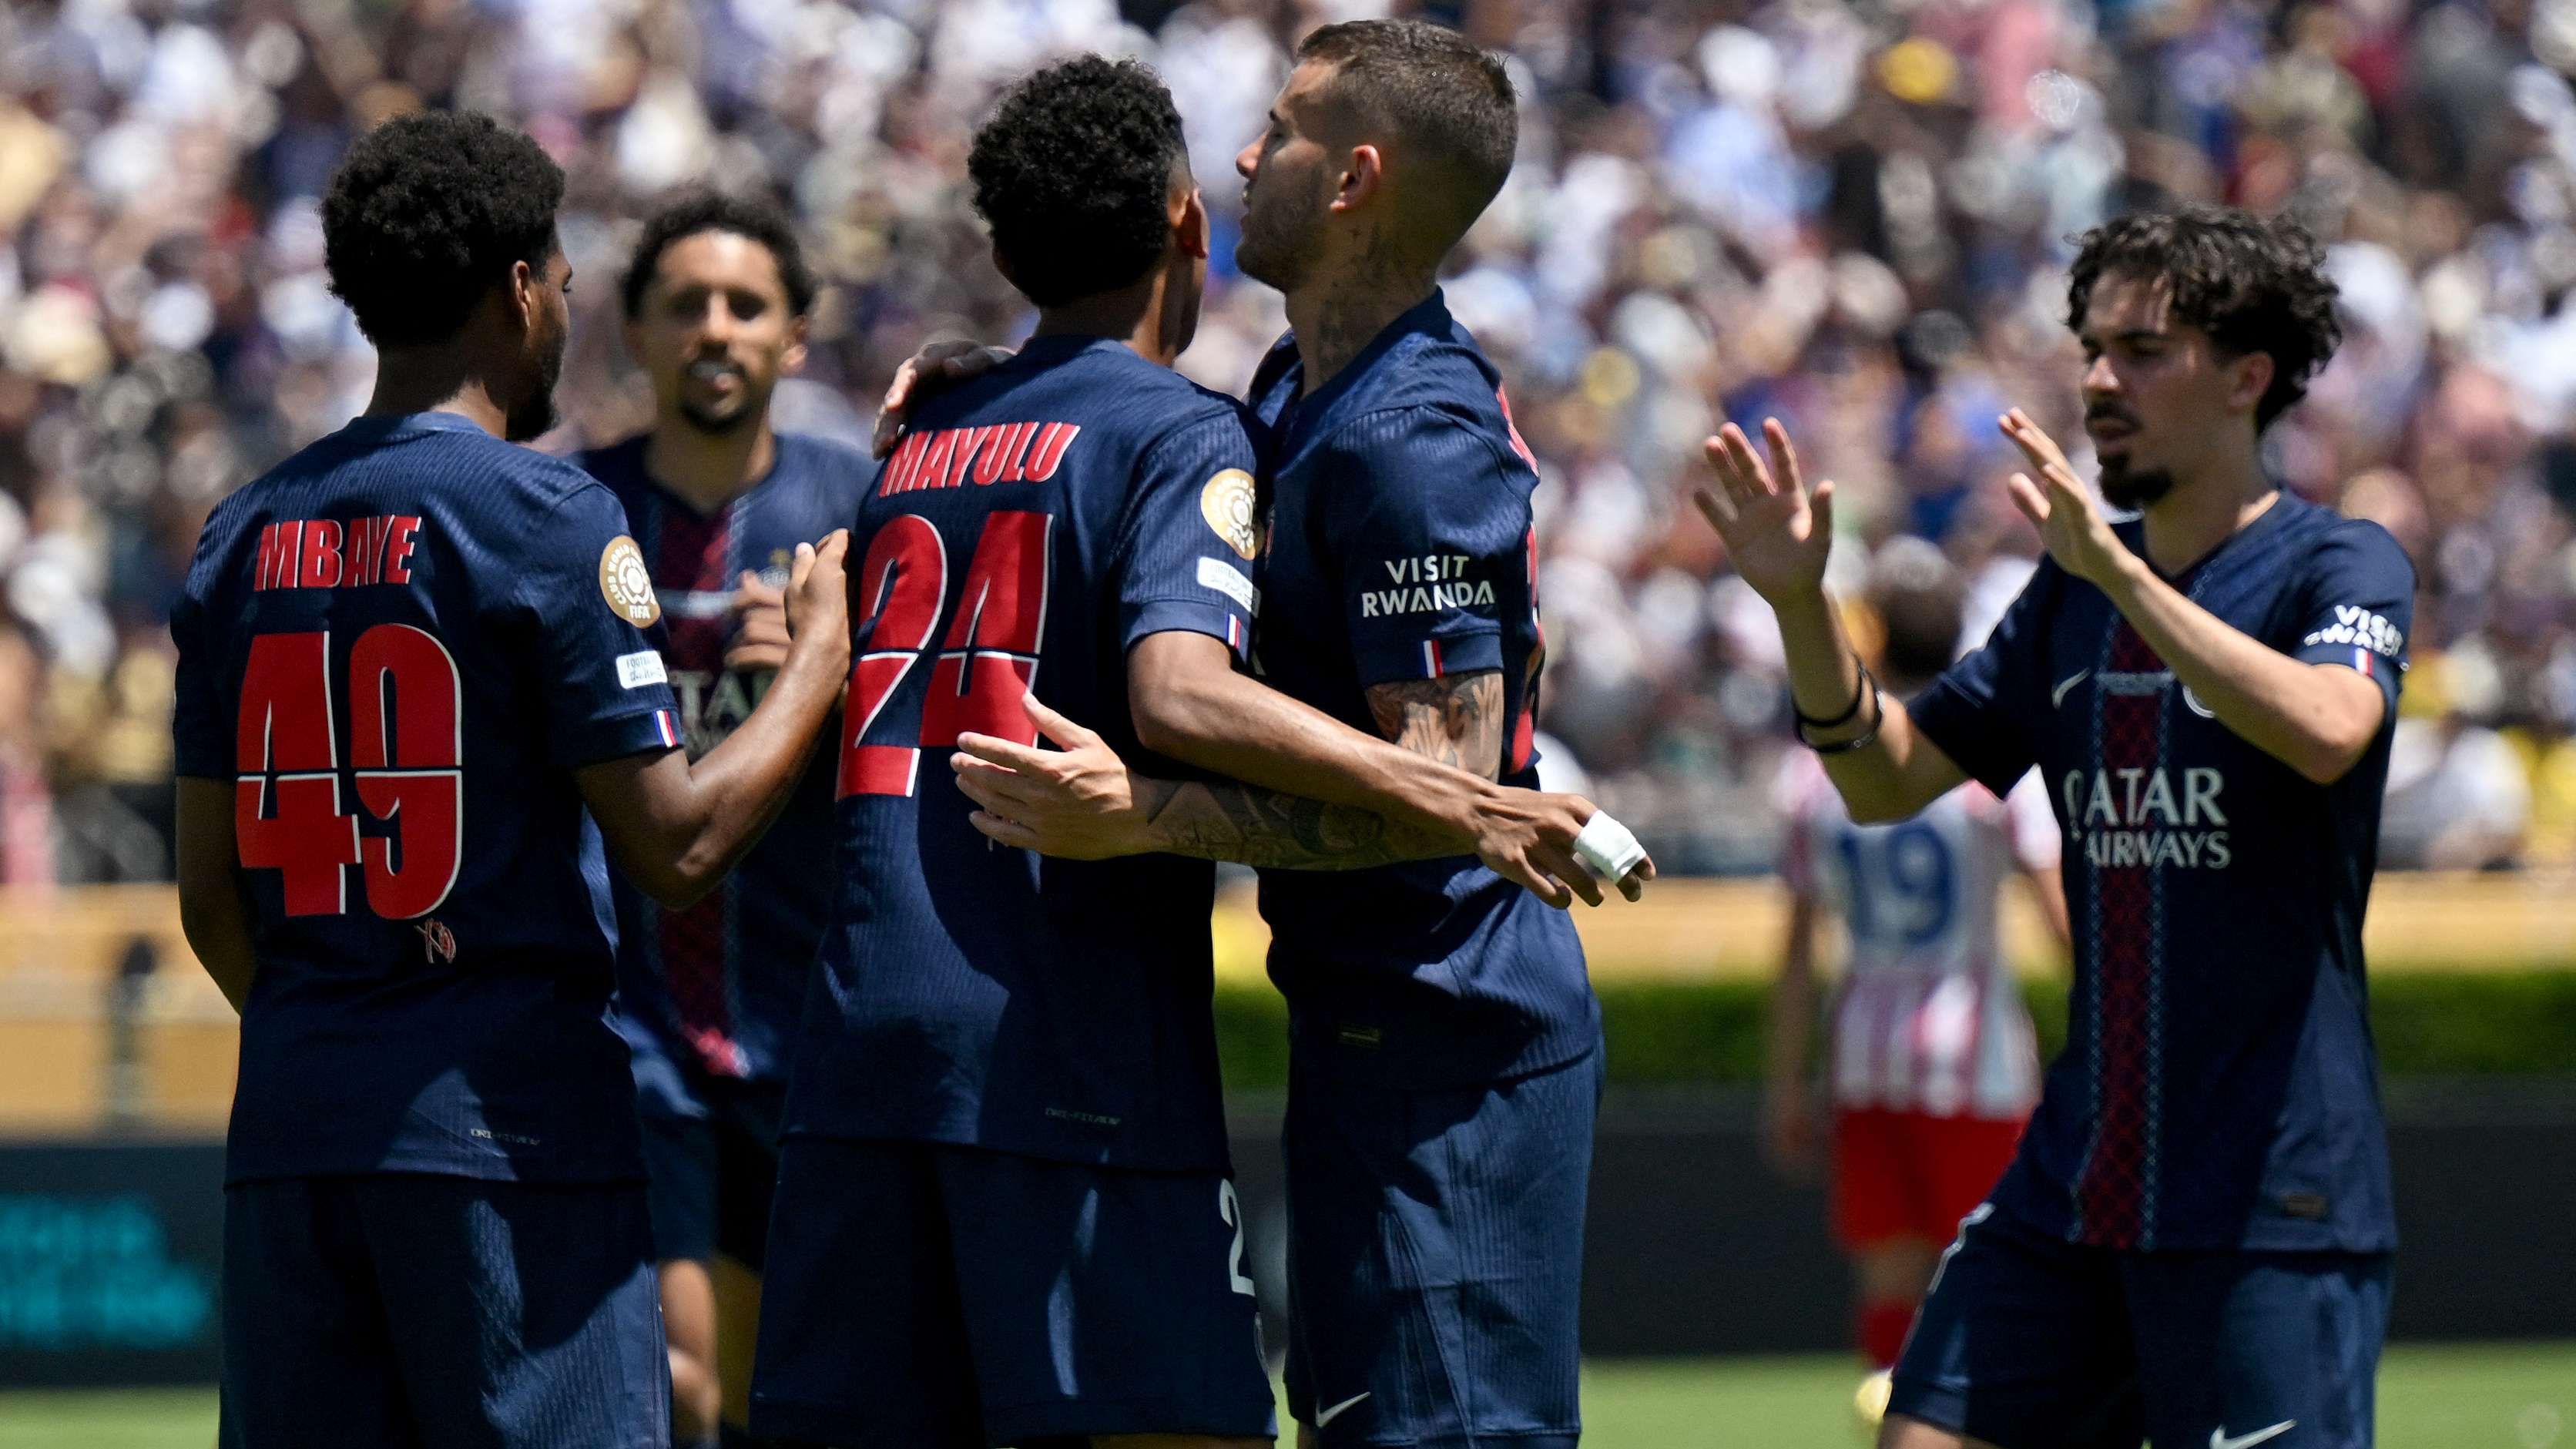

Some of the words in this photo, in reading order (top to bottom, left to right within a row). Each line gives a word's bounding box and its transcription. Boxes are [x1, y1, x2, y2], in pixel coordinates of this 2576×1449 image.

[878, 421, 1081, 498] MAYULU
[253, 514, 422, 592] MBAYE
[1385, 555, 1470, 585] VISIT
[629, 605, 651, 619] FIFA
[1361, 580, 1496, 618] RWANDA
[836, 510, 1054, 802] 24
[235, 622, 462, 919] 49
[1836, 821, 1957, 944] 19
[1219, 1178, 1256, 1296] 2
